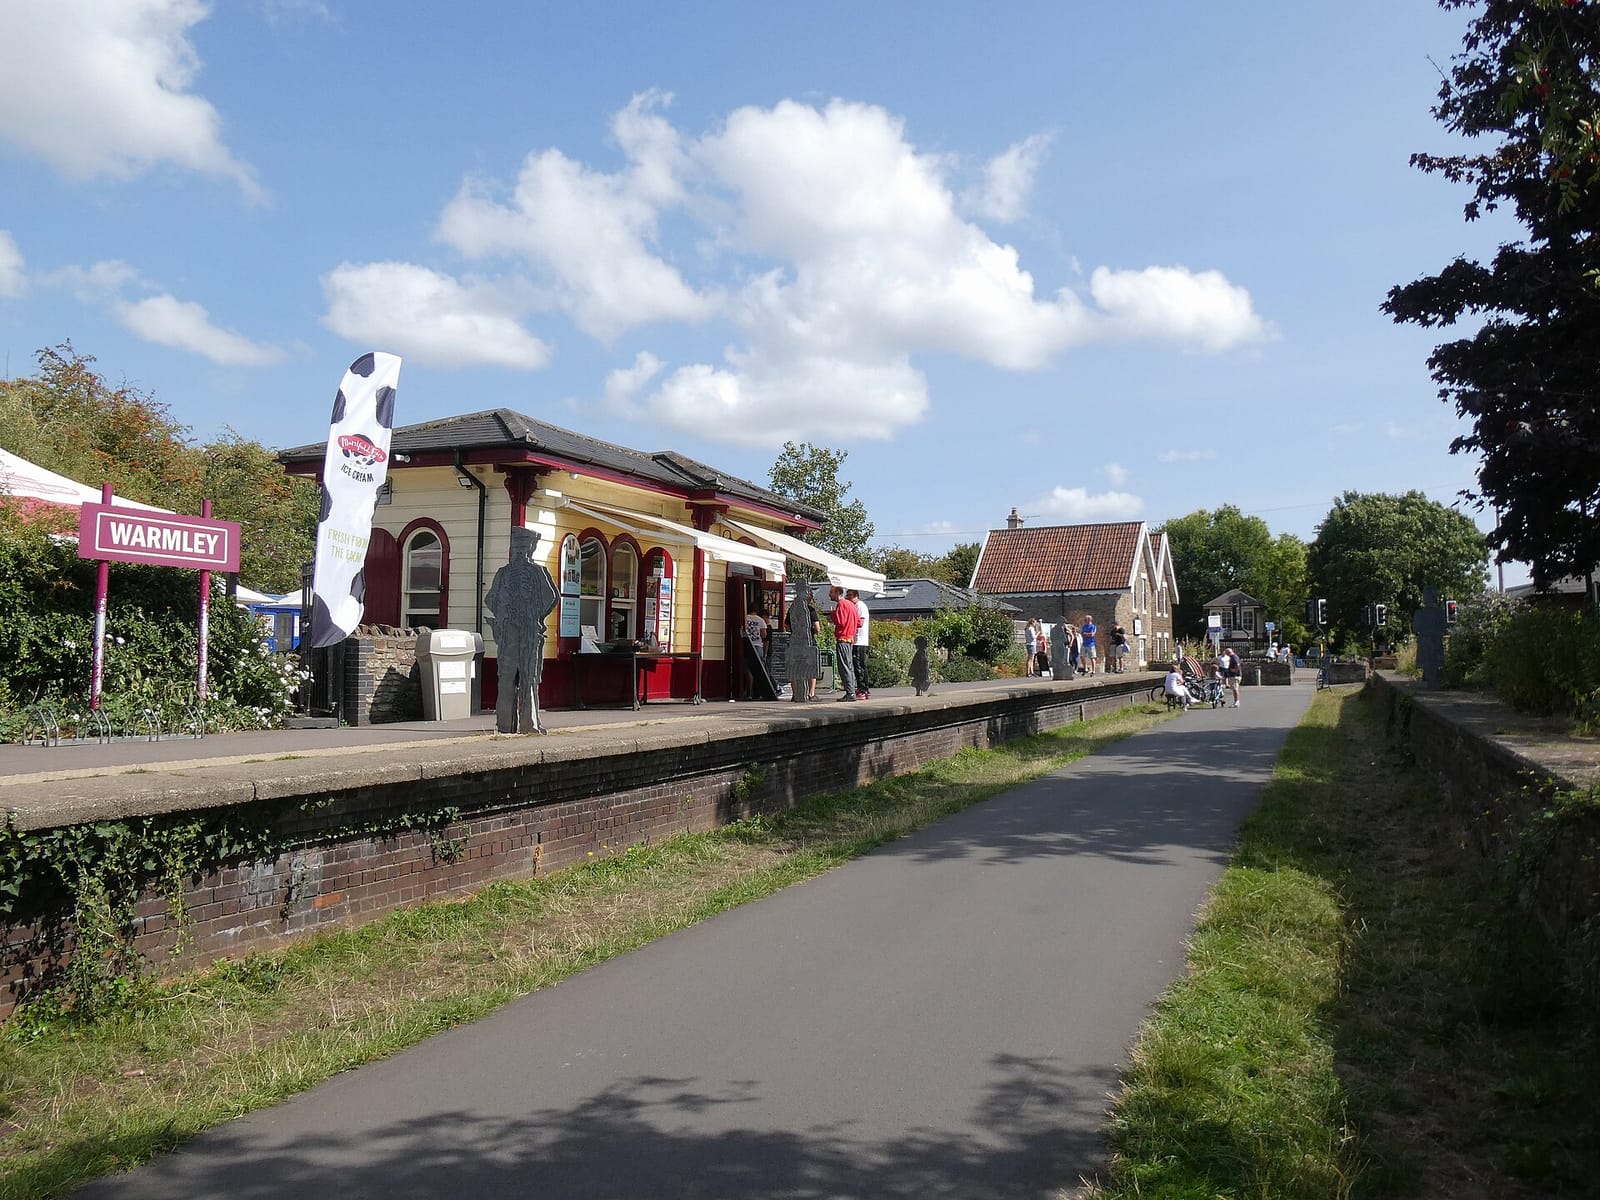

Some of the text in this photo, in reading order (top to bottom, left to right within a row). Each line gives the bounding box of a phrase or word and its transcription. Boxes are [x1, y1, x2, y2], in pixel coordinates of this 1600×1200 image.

[340, 463, 351, 477] ICE
[109, 521, 219, 555] WARMLEY
[328, 528, 350, 545] FRESH
[331, 545, 344, 560] THE
